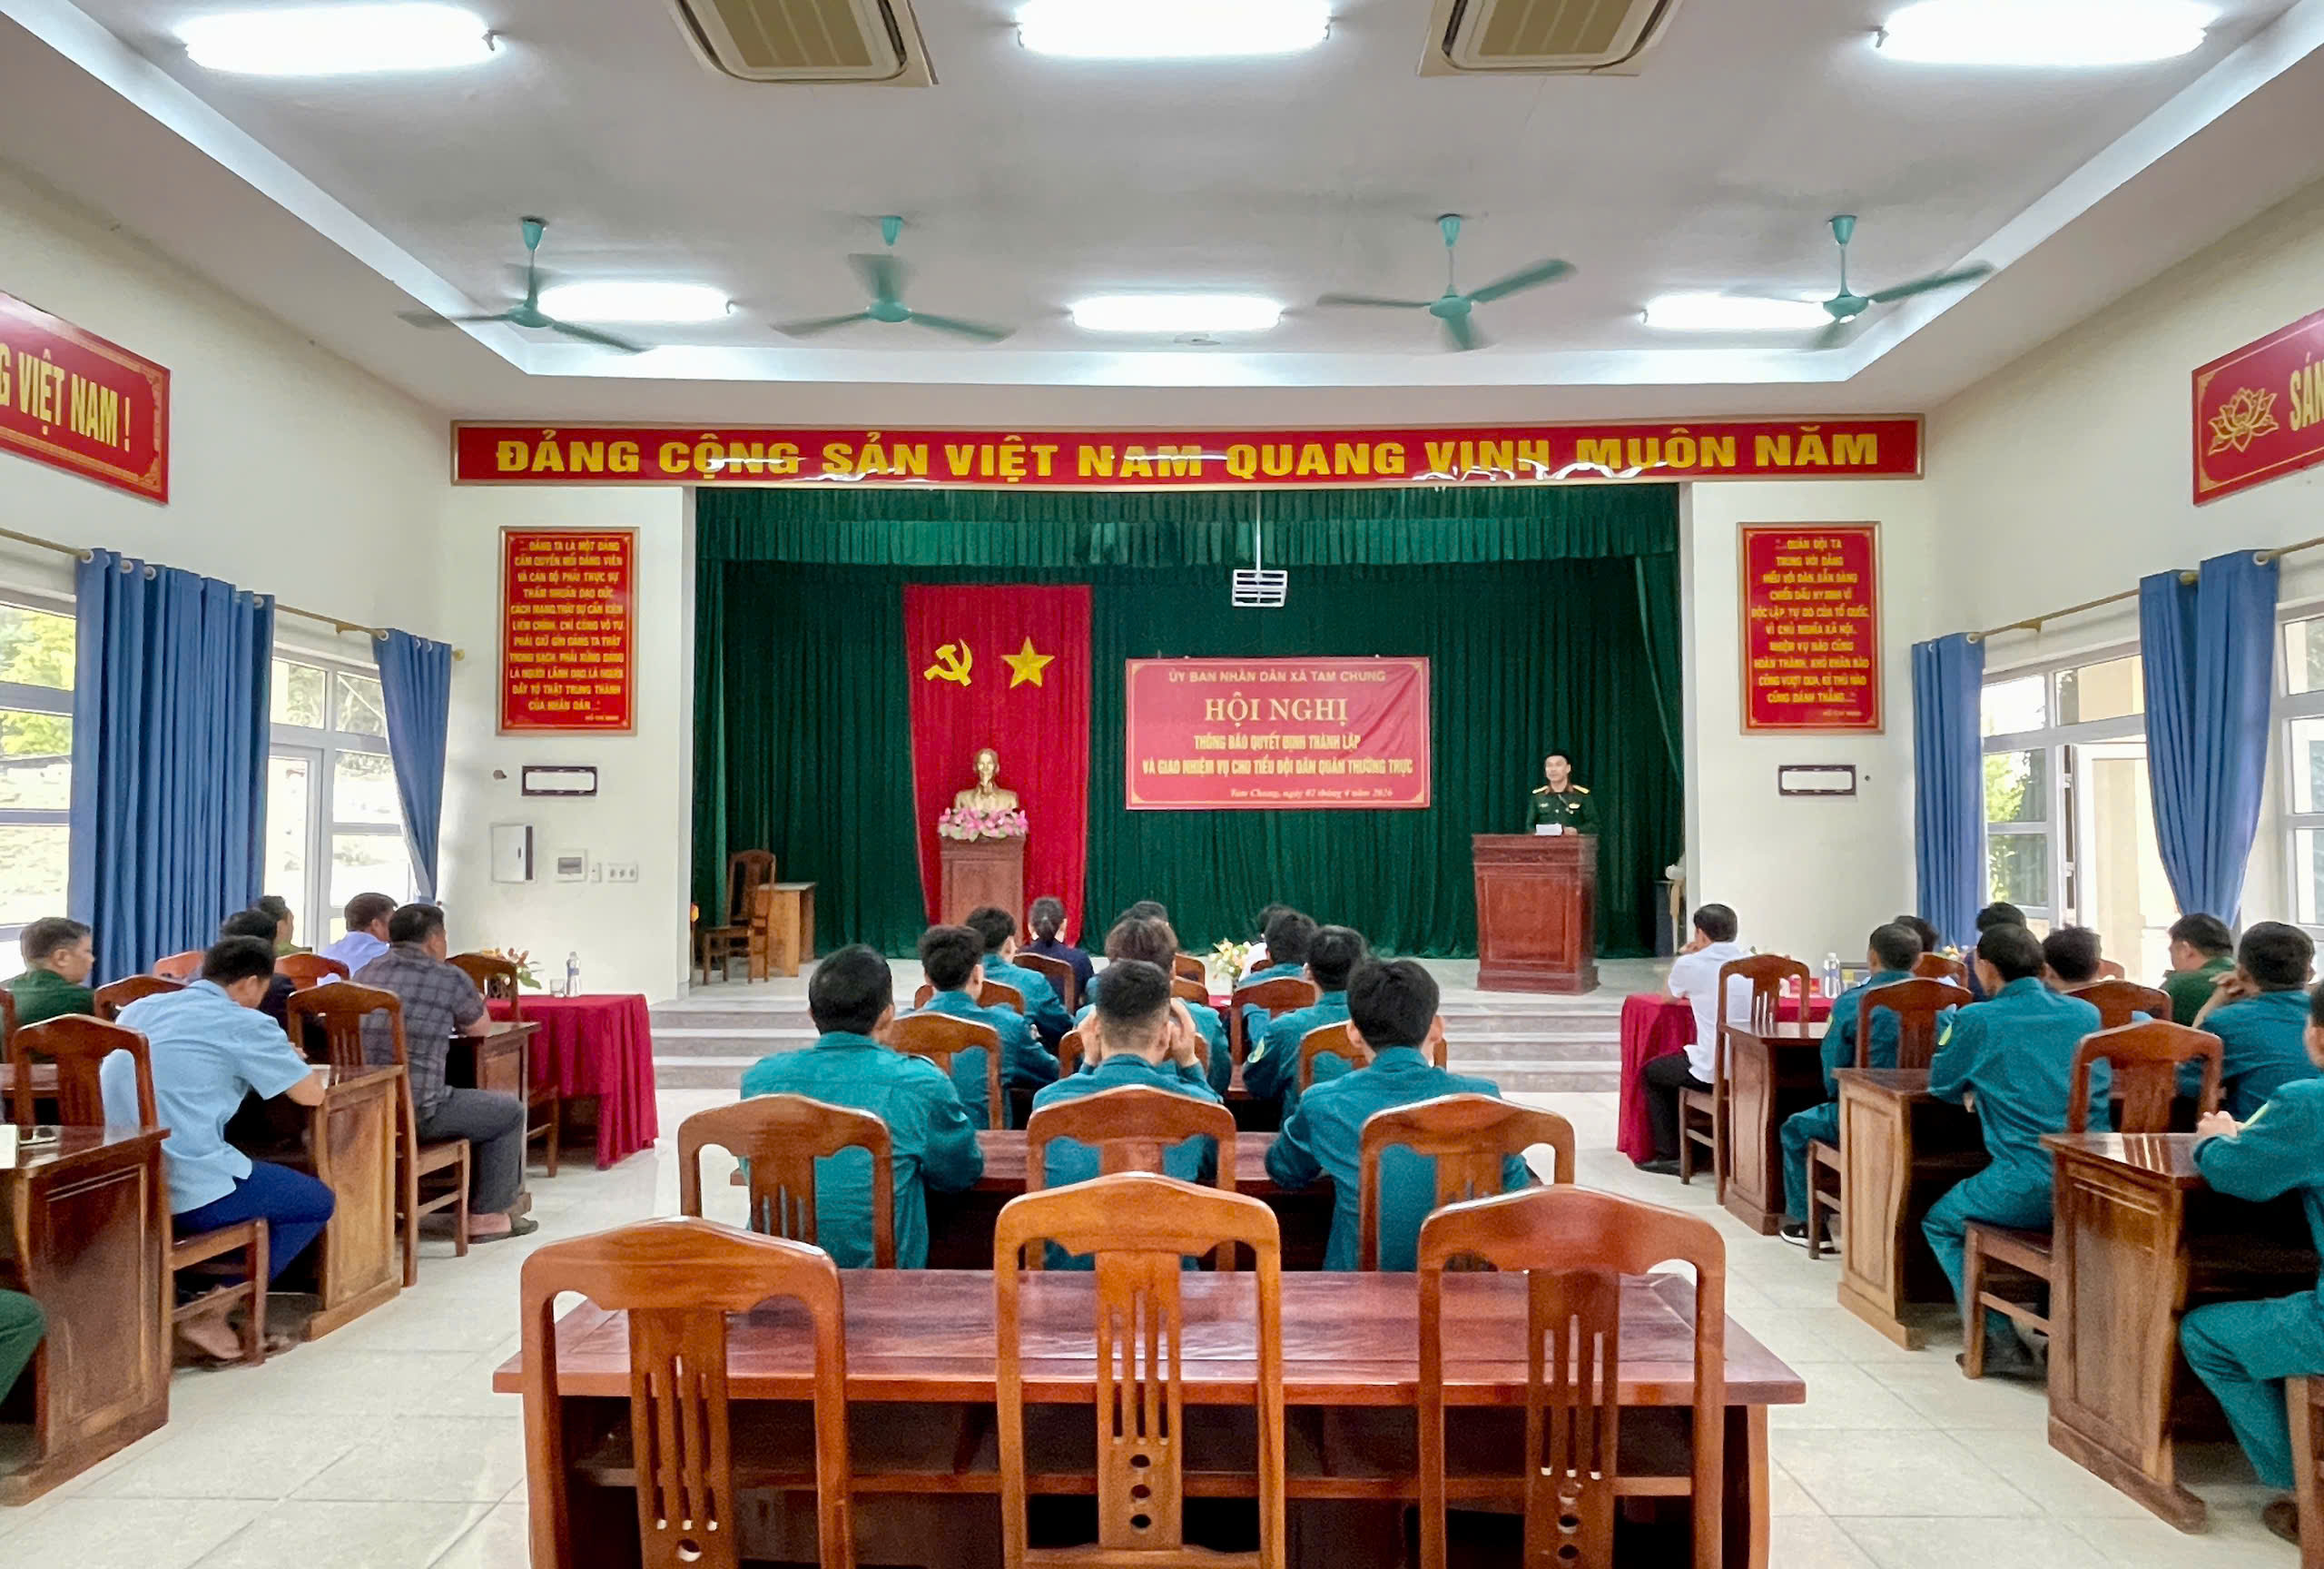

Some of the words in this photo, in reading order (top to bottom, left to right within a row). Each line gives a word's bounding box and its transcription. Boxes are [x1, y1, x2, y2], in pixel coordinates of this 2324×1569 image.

[18, 349, 65, 436] VIỆT
[71, 373, 119, 448] NAM
[496, 429, 640, 472] ĐẢNG
[658, 433, 799, 479] CỘNG
[822, 432, 928, 474] SẢN
[944, 435, 1059, 482] VIỆT
[1078, 445, 1203, 477] NAM
[1226, 442, 1406, 479] QUANG
[1424, 439, 1550, 473] VINH
[1576, 428, 1736, 469] MUÔN
[1756, 426, 1878, 467] NĂM
[591, 636, 600, 646] TA
[1189, 671, 1217, 682] BAN
[1220, 668, 1256, 682] NHÂN
[1259, 668, 1286, 682] DÂN
[1290, 668, 1308, 682] XÃ
[1311, 671, 1336, 682] TAM
[1340, 671, 1386, 682] CHUNG
[1205, 691, 1261, 728] HỘI
[1268, 697, 1349, 727] NGHỊ
[1228, 732, 1248, 750] BÁO
[1251, 730, 1281, 751] QUYẾT
[1308, 732, 1340, 750] THÀNH
